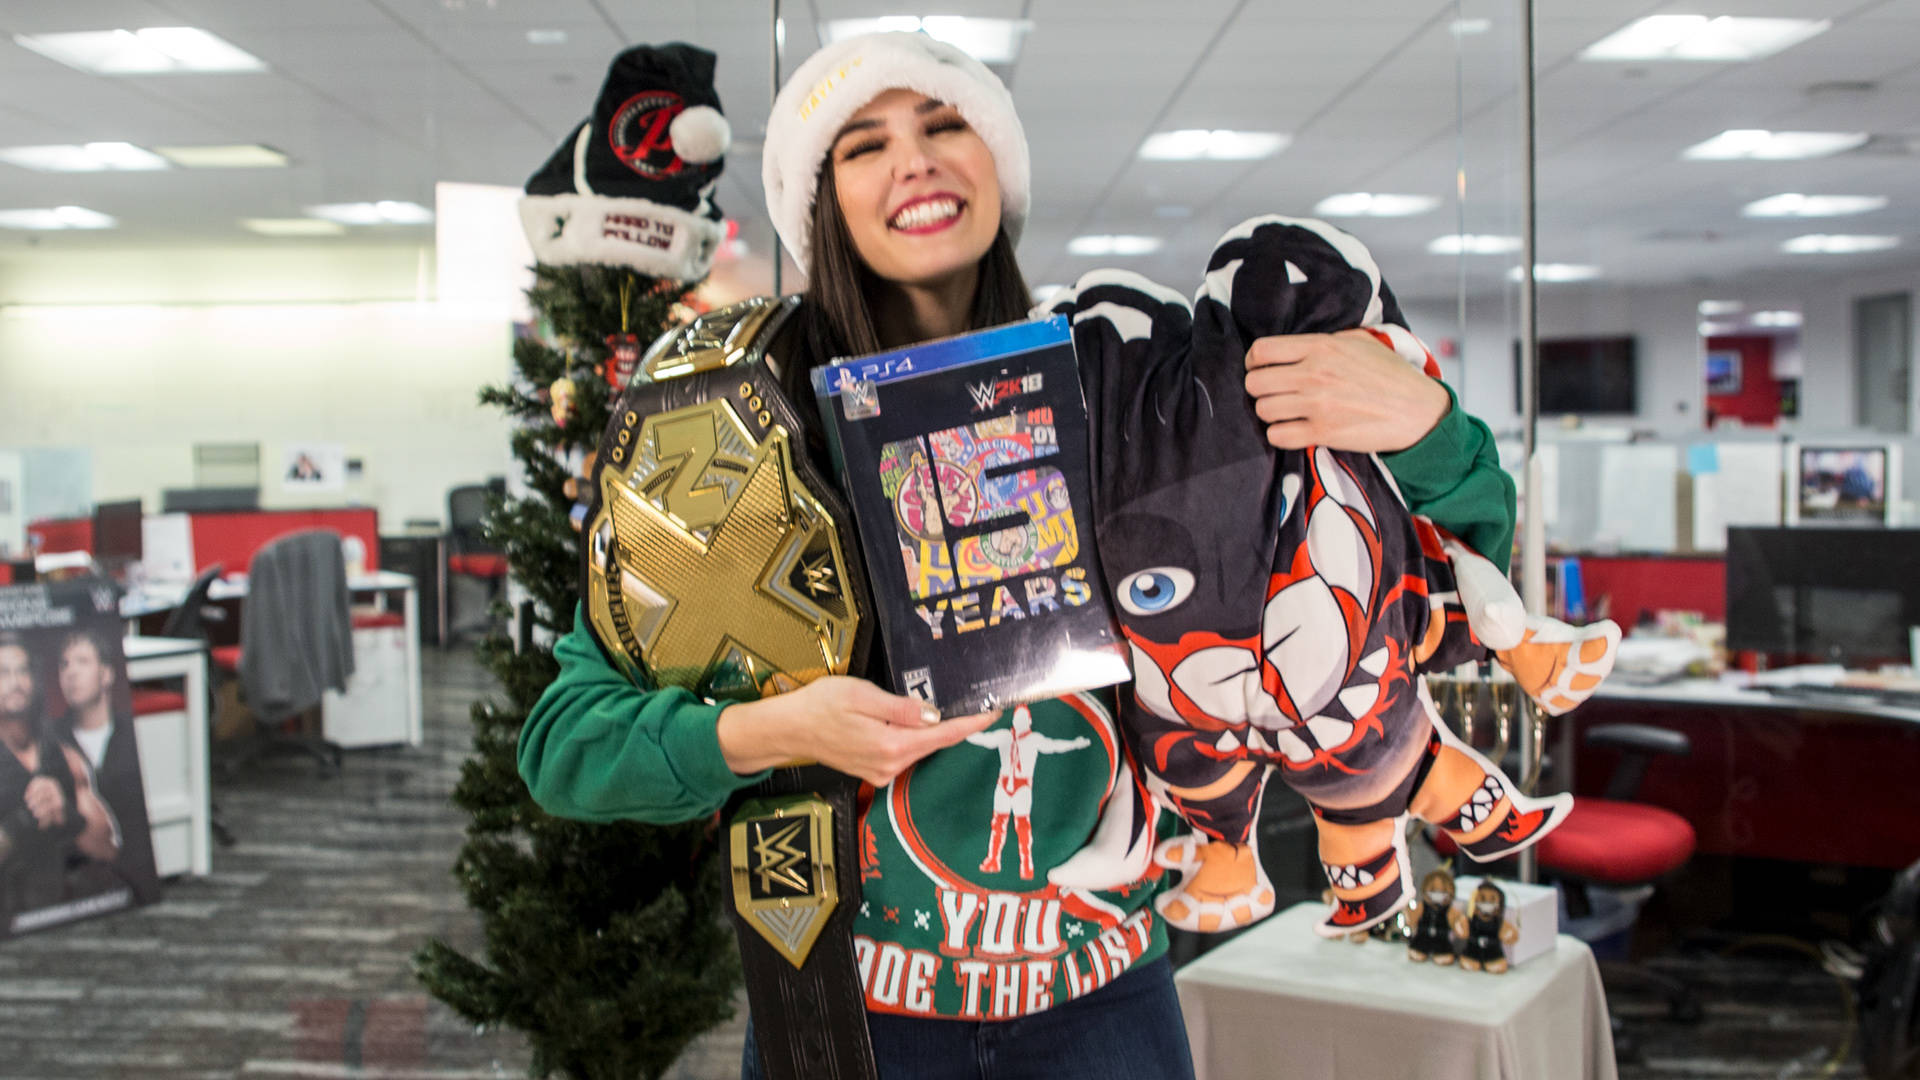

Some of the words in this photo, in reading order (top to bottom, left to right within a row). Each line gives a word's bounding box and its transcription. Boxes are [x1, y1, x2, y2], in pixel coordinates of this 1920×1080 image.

[655, 219, 675, 236] TO
[861, 356, 914, 381] PS4
[915, 566, 1092, 640] YEARS
[910, 680, 929, 700] T
[938, 889, 1065, 956] YOU
[957, 960, 1057, 1018] THE
[1065, 910, 1153, 1002] LIST
